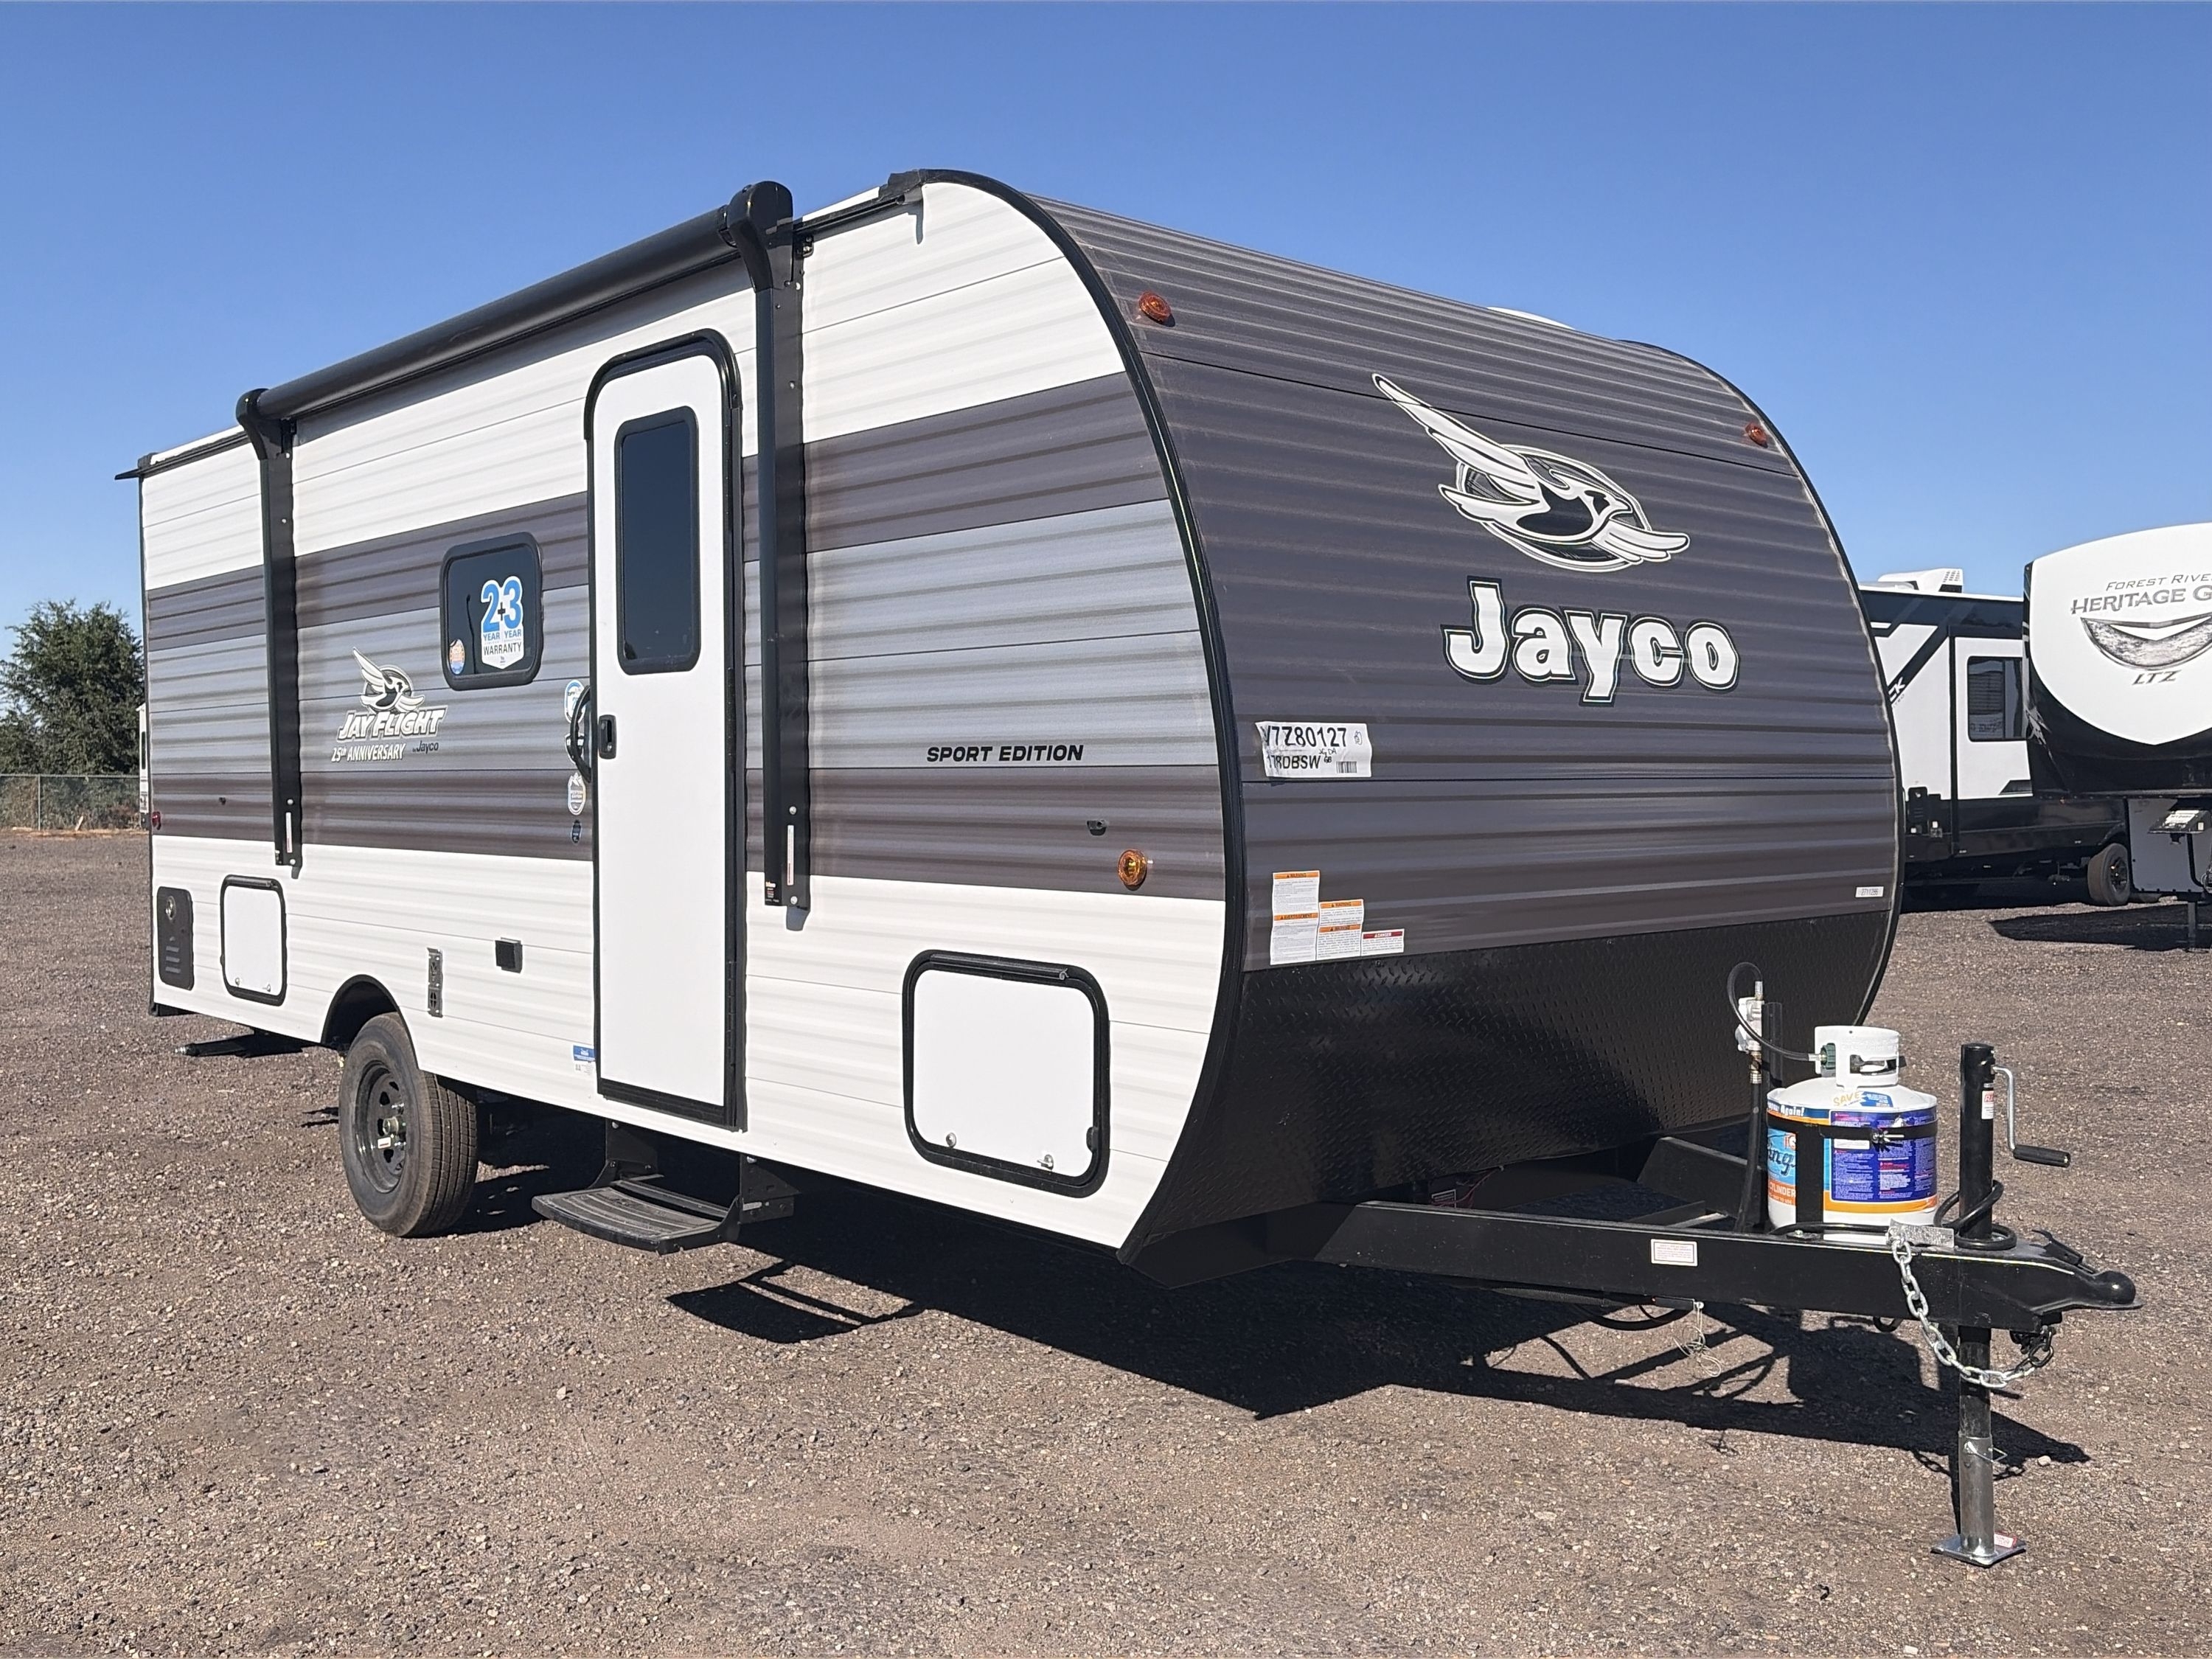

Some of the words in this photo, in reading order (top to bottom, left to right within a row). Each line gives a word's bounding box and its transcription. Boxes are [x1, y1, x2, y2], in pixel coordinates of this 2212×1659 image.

[2106, 577, 2168, 591] FOREST
[2171, 573, 2212, 584] RIVE
[2070, 588, 2186, 614] HERITAGE
[483, 632, 500, 641] YEAR
[504, 629, 522, 639] YEAR
[1441, 575, 1739, 706] Jayco
[483, 641, 522, 656] WARRANTY
[2132, 669, 2182, 685] LTZ
[338, 711, 375, 741] JAY
[372, 707, 447, 739] FLIGHT
[347, 742, 406, 762] ANNIVERSARY
[416, 740, 439, 754] Jayco
[926, 746, 993, 762] SPORT
[998, 745, 1084, 762] EDITION
[1833, 1091, 1860, 1106] SAVE
[1781, 1105, 1804, 1116] Again!
